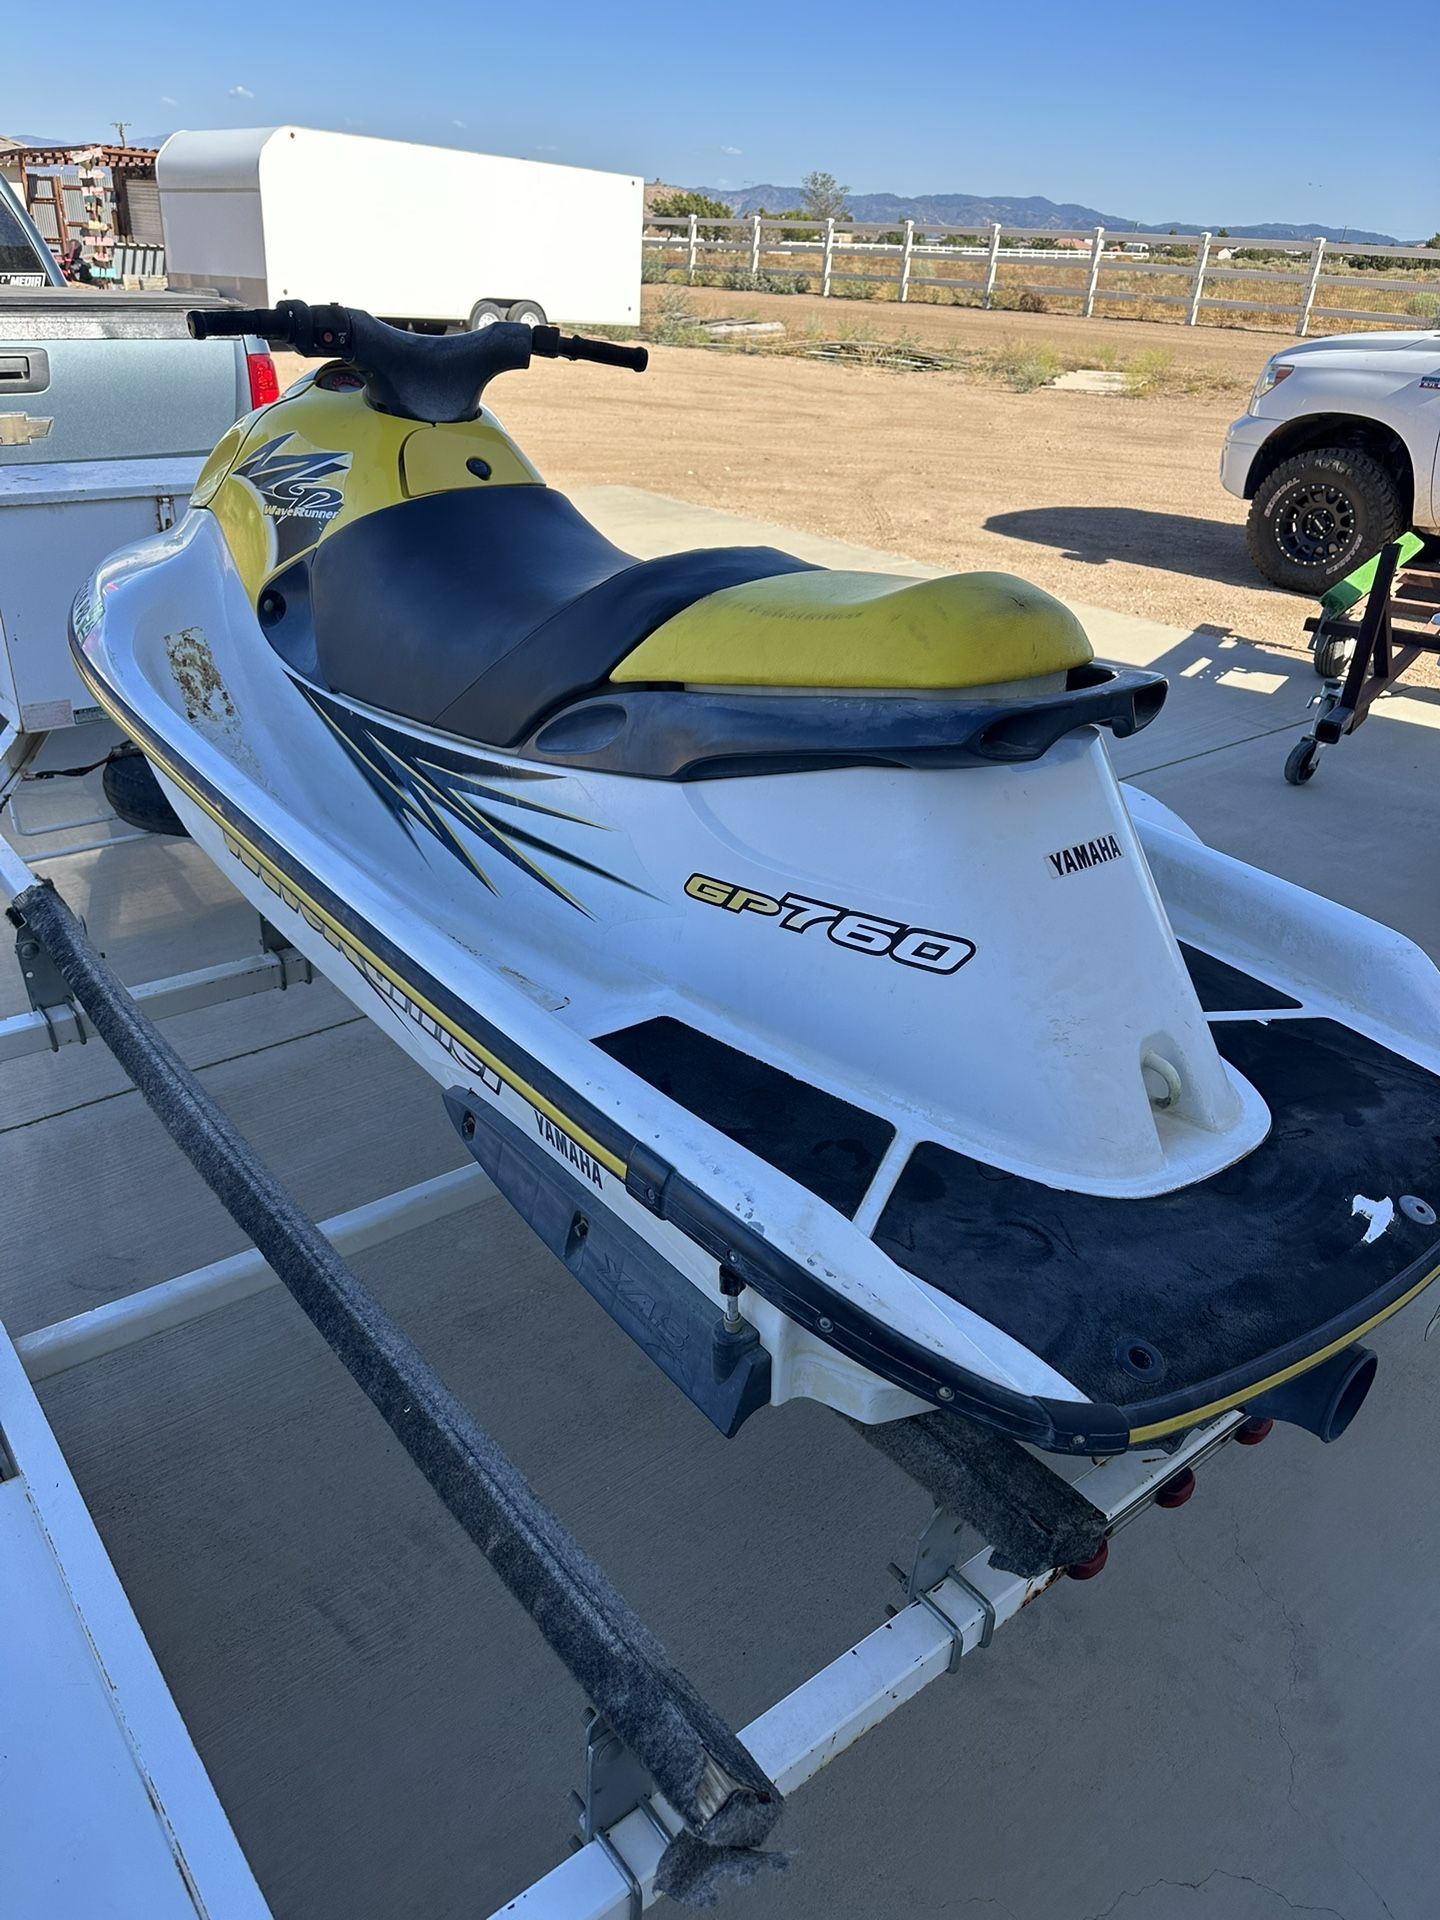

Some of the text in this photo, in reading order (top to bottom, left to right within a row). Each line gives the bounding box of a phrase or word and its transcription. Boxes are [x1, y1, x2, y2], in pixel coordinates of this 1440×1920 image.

[10, 275, 42, 287] MEDIA
[263, 503, 338, 519] WaveRunner
[1048, 834, 1122, 876] YAMAHA
[683, 871, 977, 976] GP760
[533, 1109, 603, 1190] YAMAHA
